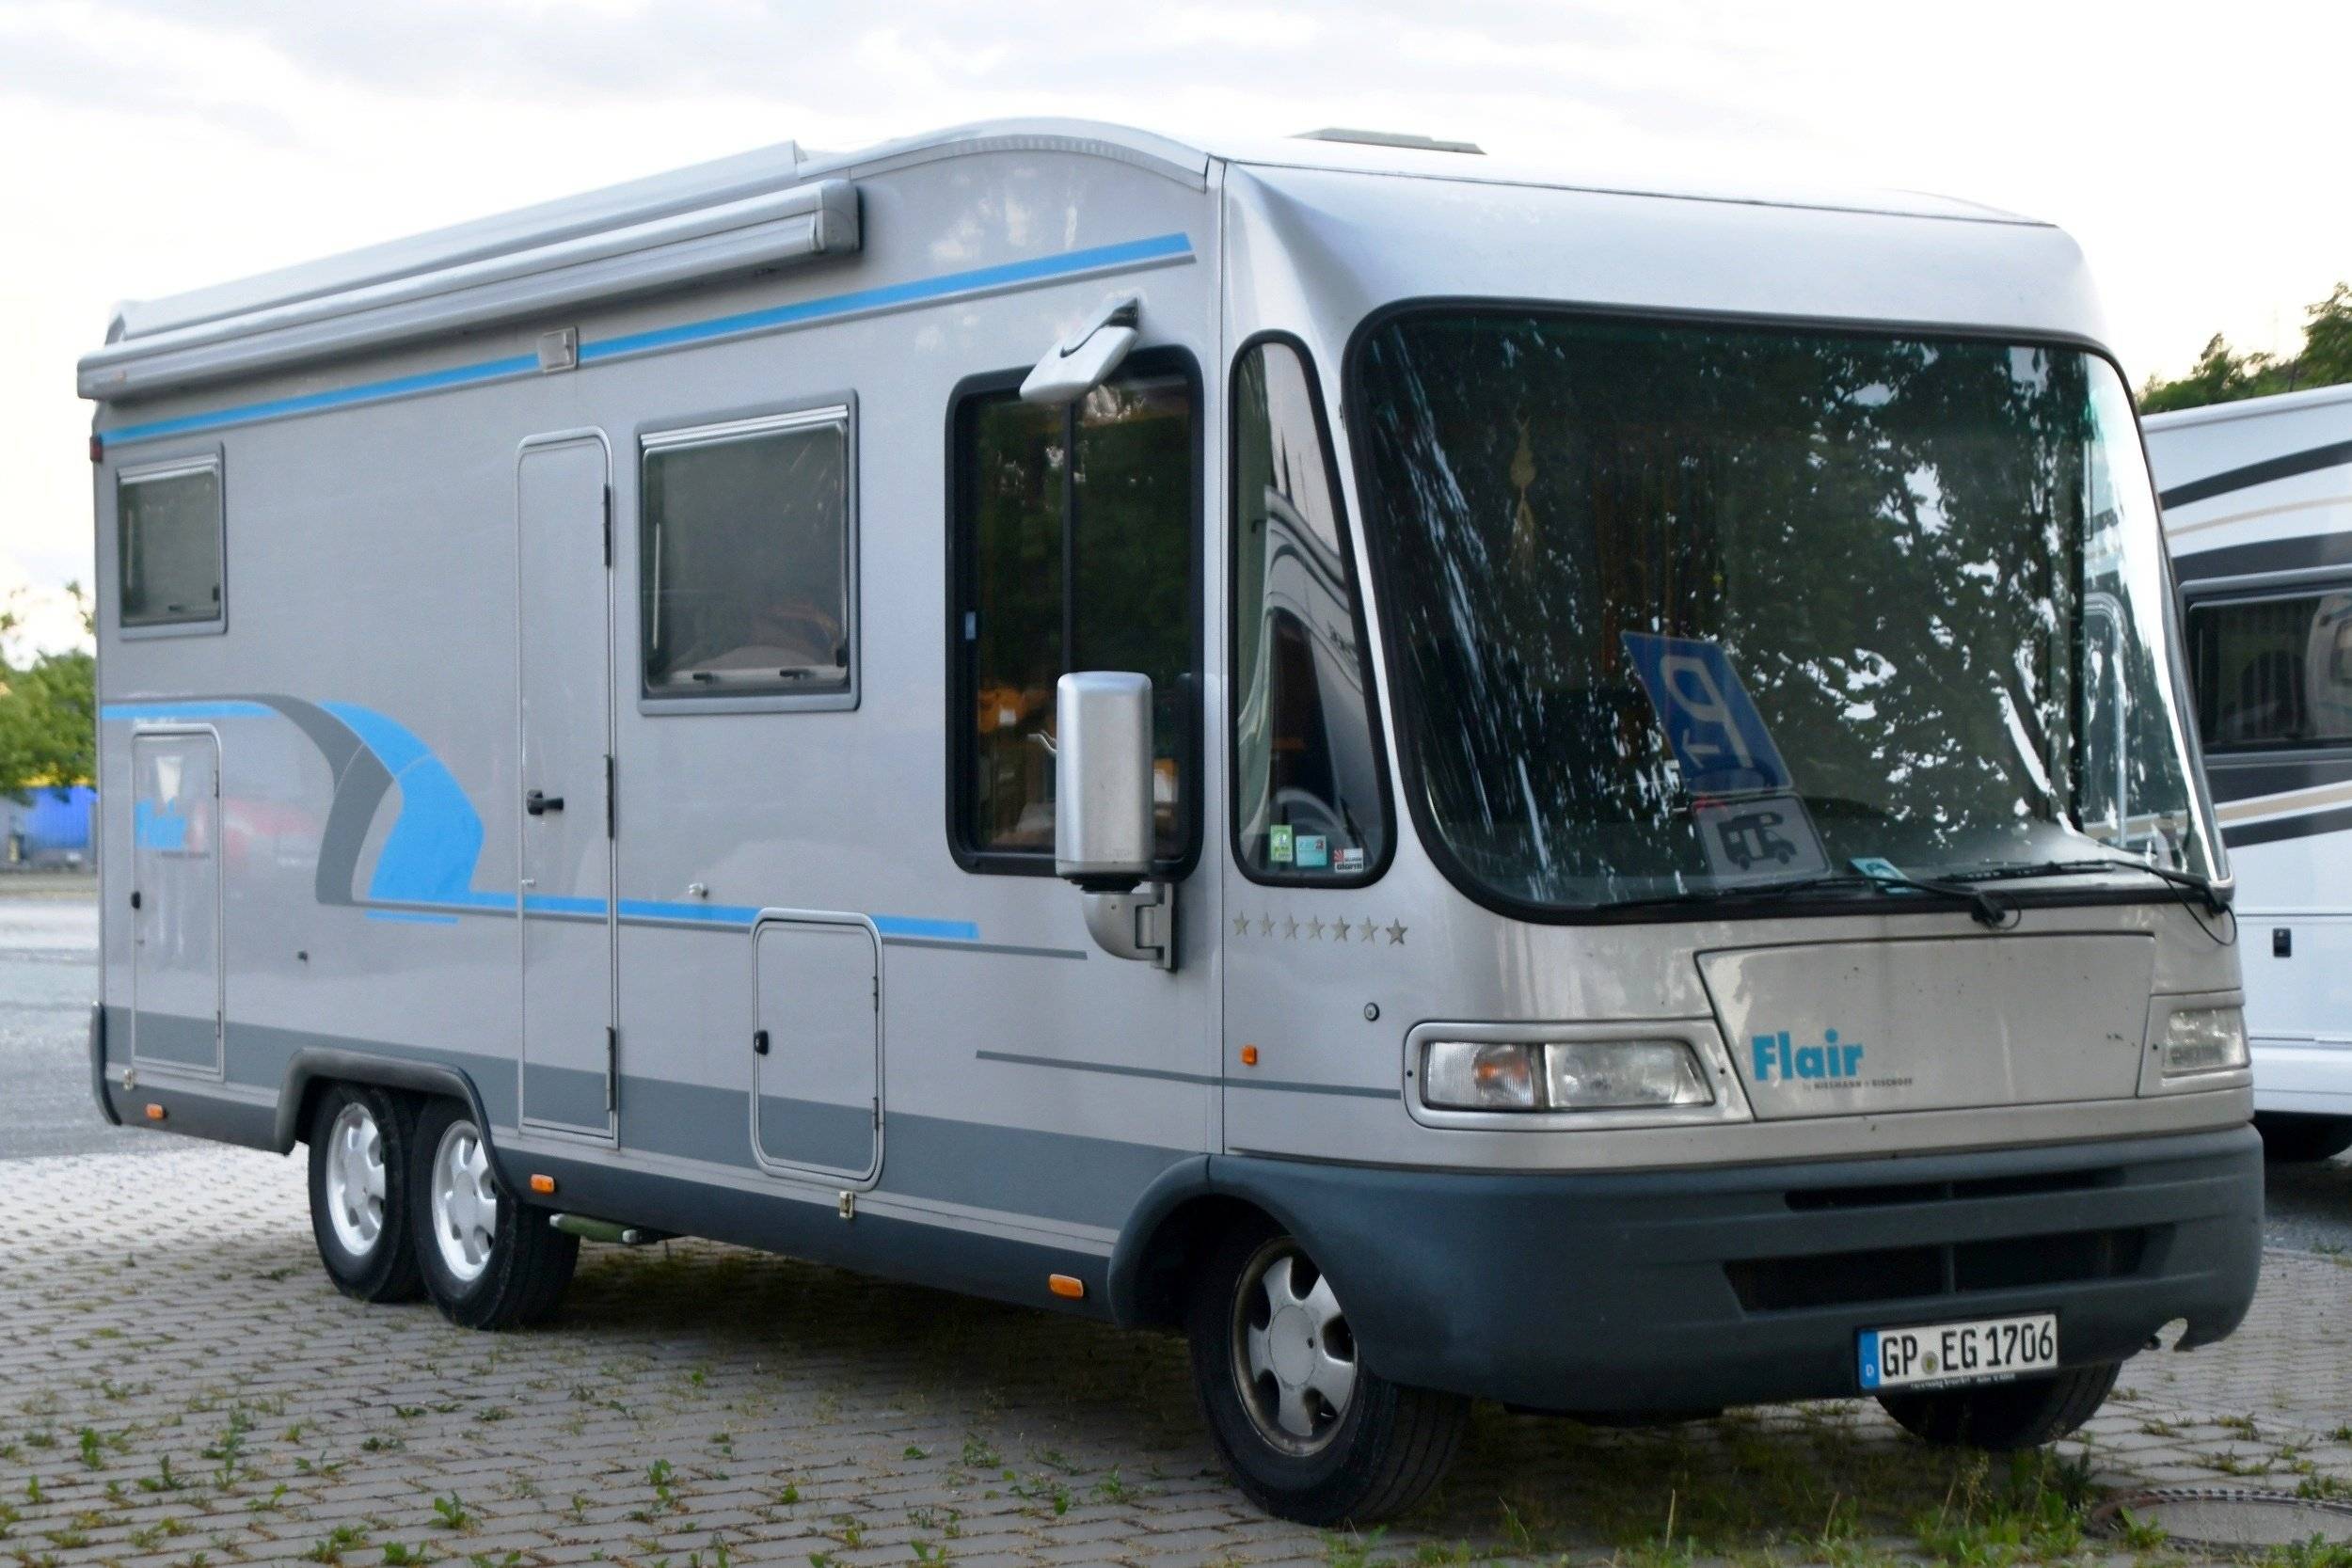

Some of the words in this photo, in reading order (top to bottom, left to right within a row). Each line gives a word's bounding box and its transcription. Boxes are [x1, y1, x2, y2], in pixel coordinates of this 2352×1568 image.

[1752, 1028, 1864, 1081] Flair
[1882, 1334, 1918, 1378] GP
[1941, 1327, 1979, 1372] EG
[1985, 1321, 2054, 1368] 1706
